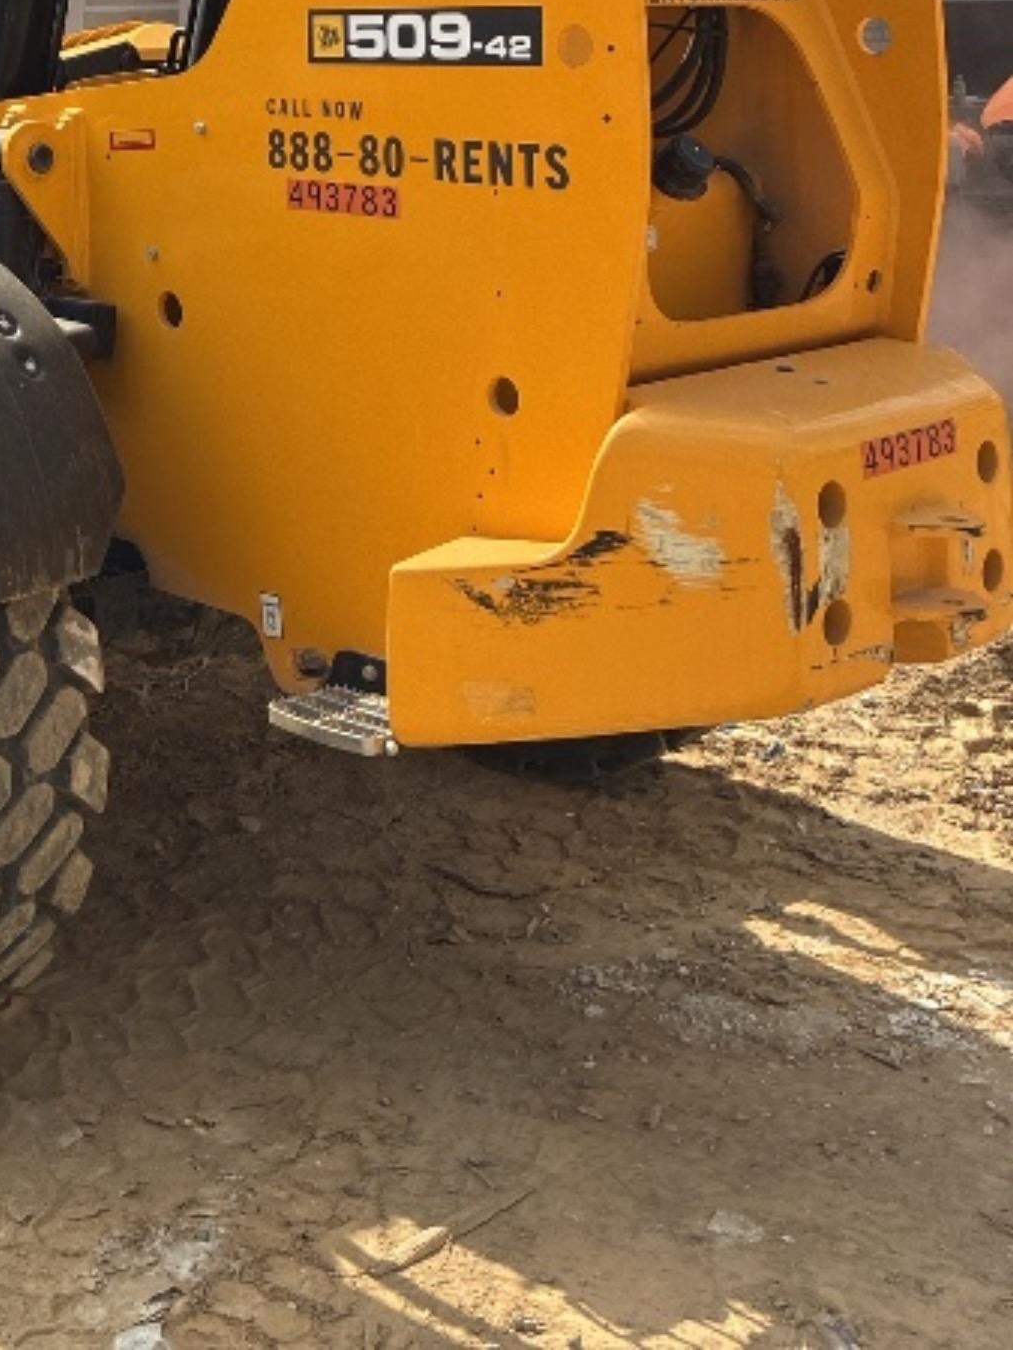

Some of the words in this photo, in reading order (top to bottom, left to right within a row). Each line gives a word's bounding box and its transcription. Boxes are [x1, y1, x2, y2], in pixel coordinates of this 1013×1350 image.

[347, 12, 532, 60] 509-42
[266, 97, 312, 118] CALL
[322, 100, 363, 121] NOW
[268, 129, 570, 190] 888-80-RENTS
[290, 182, 397, 217] 493783
[864, 419, 956, 472] 493783
